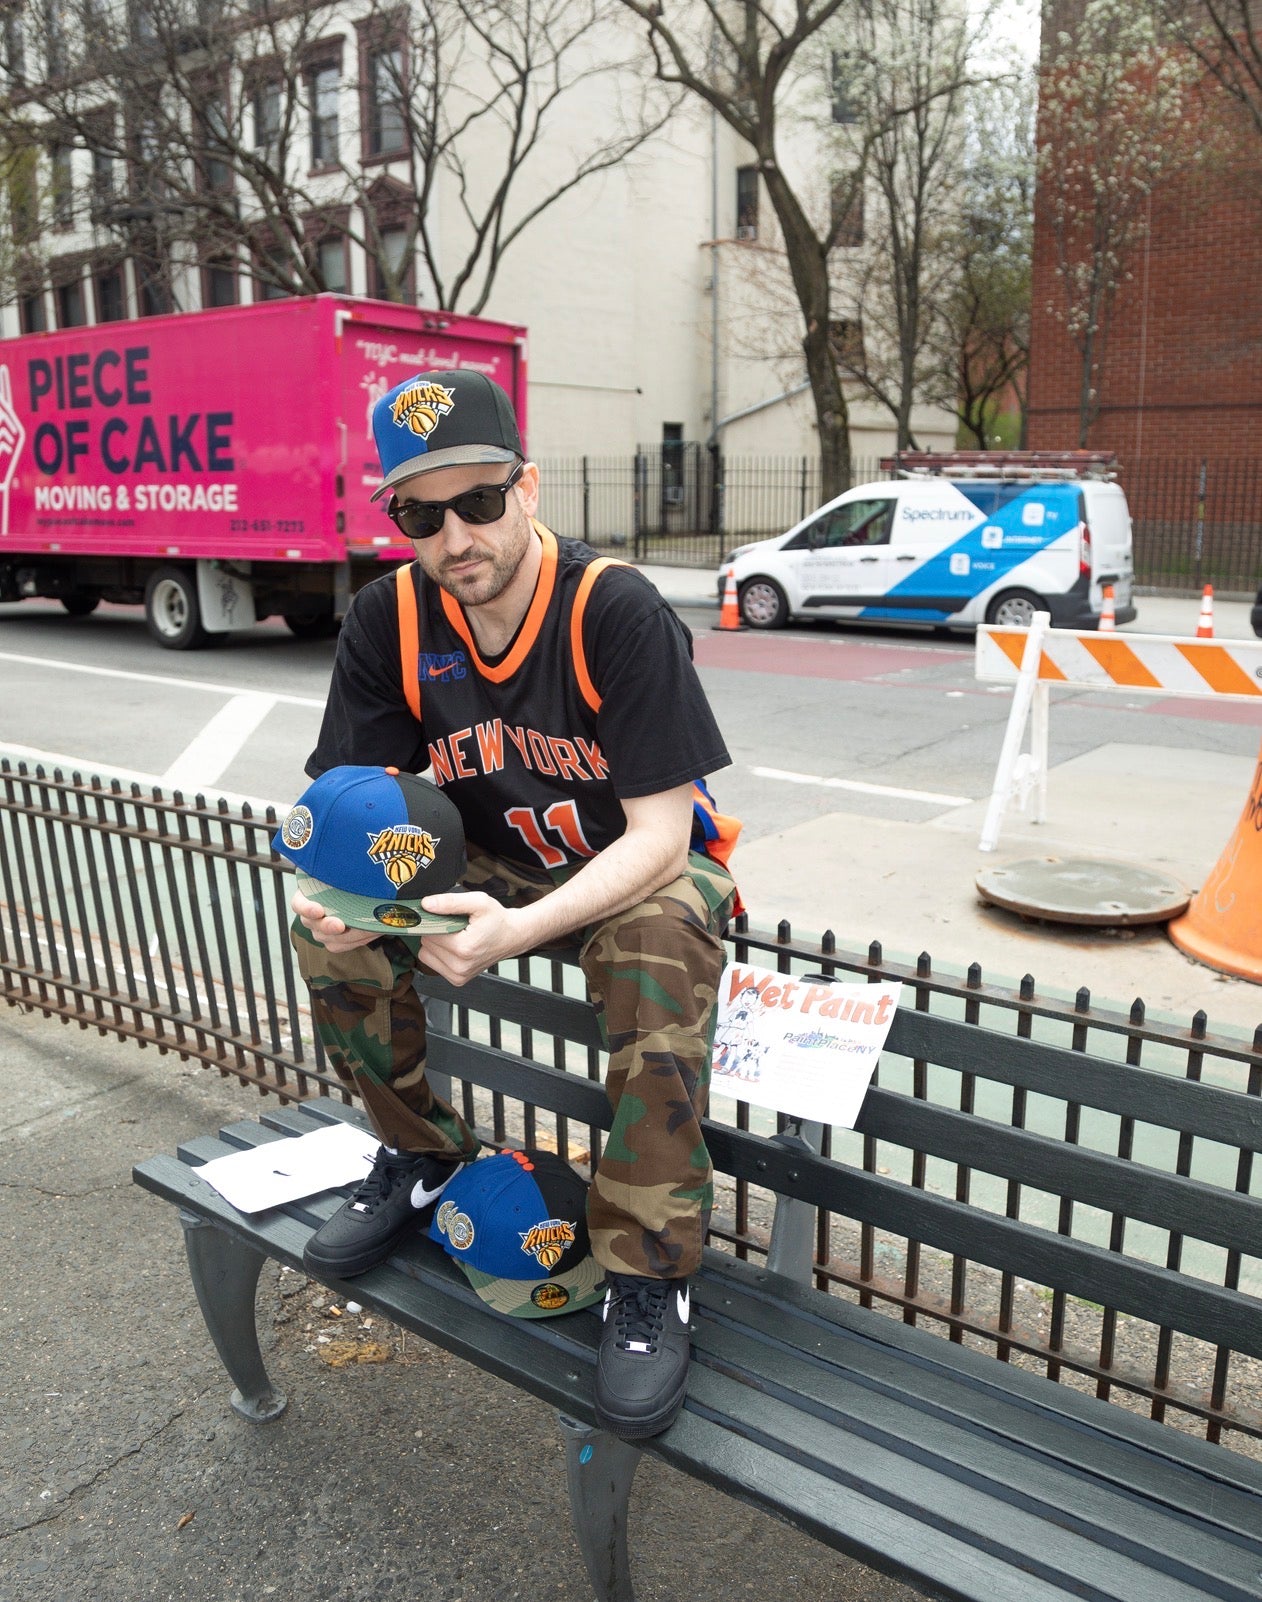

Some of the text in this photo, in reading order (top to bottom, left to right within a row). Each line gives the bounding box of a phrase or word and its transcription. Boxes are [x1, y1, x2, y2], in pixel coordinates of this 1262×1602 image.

[28, 346, 151, 412] PIECE
[393, 383, 454, 422] KNICKS
[34, 412, 234, 475] OF CAKE
[34, 484, 239, 511] MOVING & STORAGE
[903, 507, 971, 522] Spectrum
[418, 651, 467, 682] NYC
[428, 718, 610, 787] NEW YORK
[369, 830, 436, 860] KNICKS
[504, 799, 600, 869] 11
[726, 968, 893, 1026] Wet Paint
[523, 1222, 575, 1250] KNICKS
